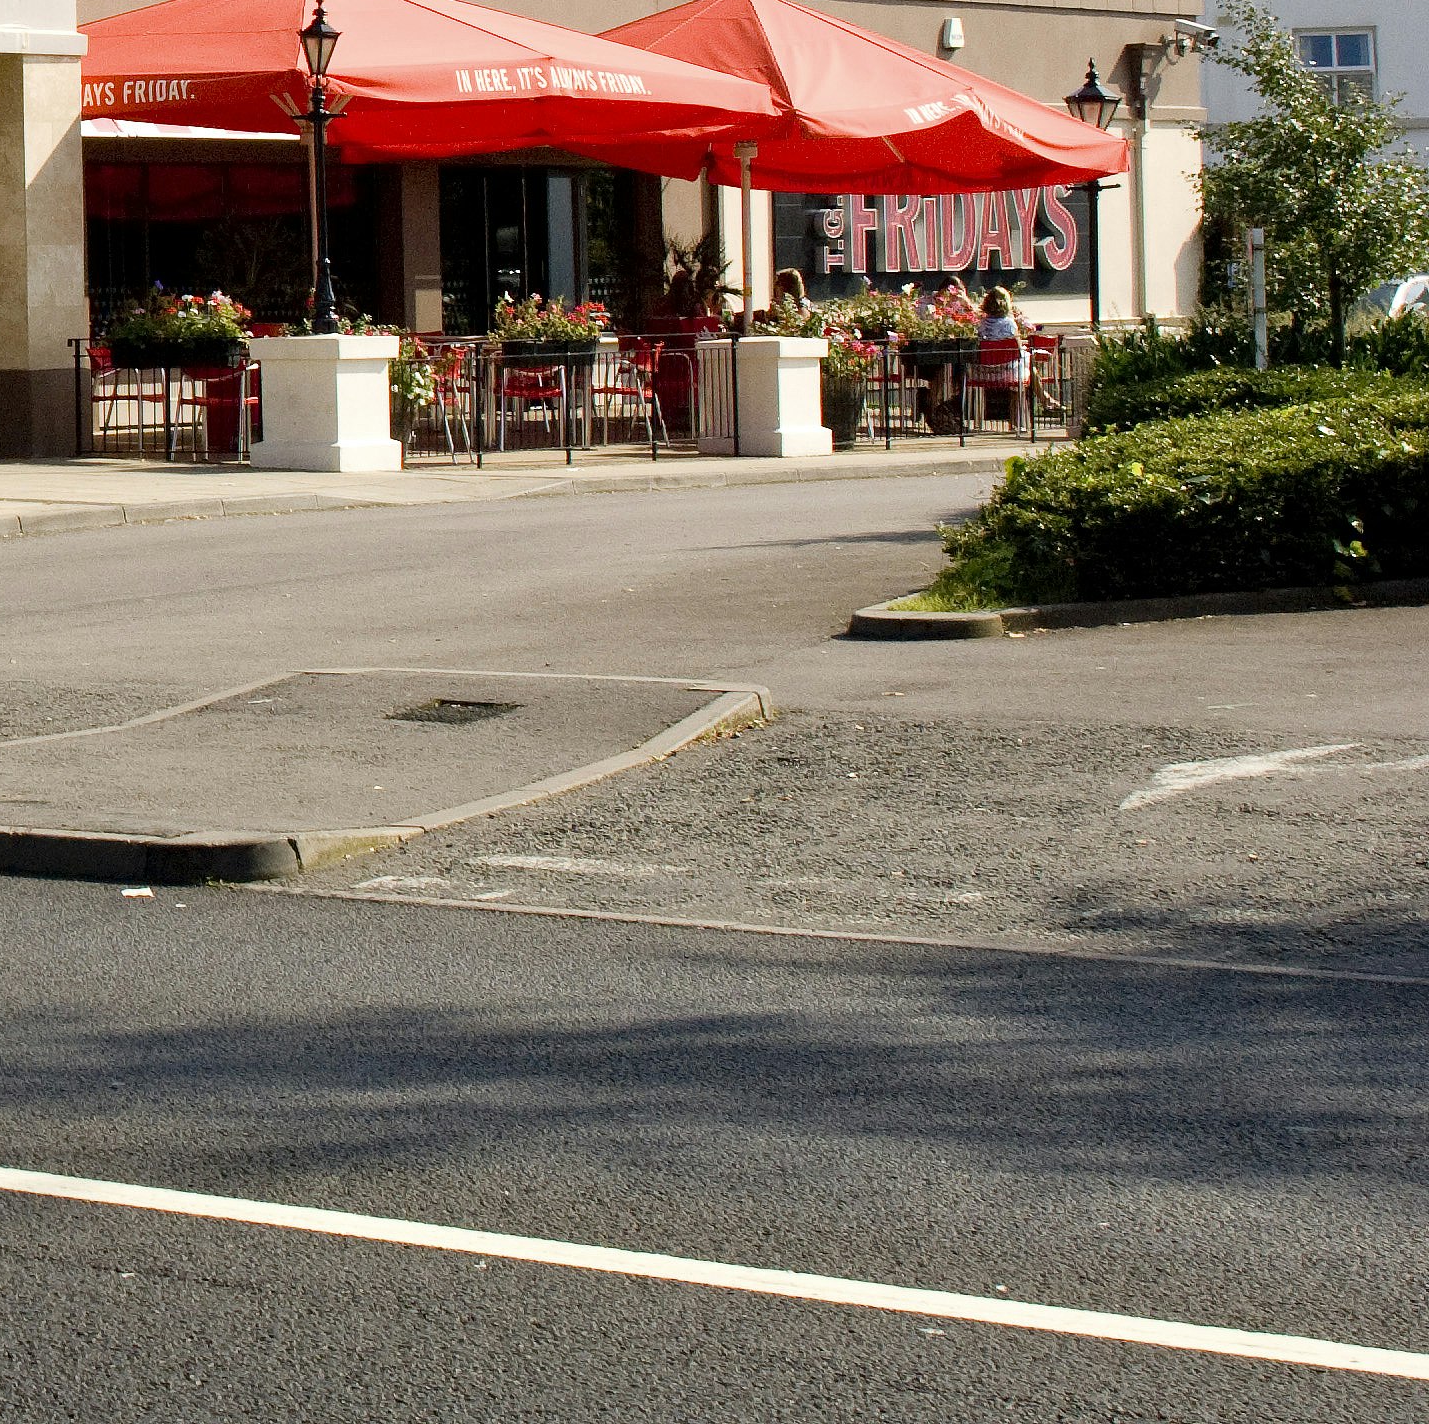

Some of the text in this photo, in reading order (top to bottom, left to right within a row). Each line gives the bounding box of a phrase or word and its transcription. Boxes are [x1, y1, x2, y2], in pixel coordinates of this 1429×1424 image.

[122, 79, 196, 105] FRIDAY.
[455, 66, 653, 96] IN HERE, IT'S ALWAYS FRIDAY.
